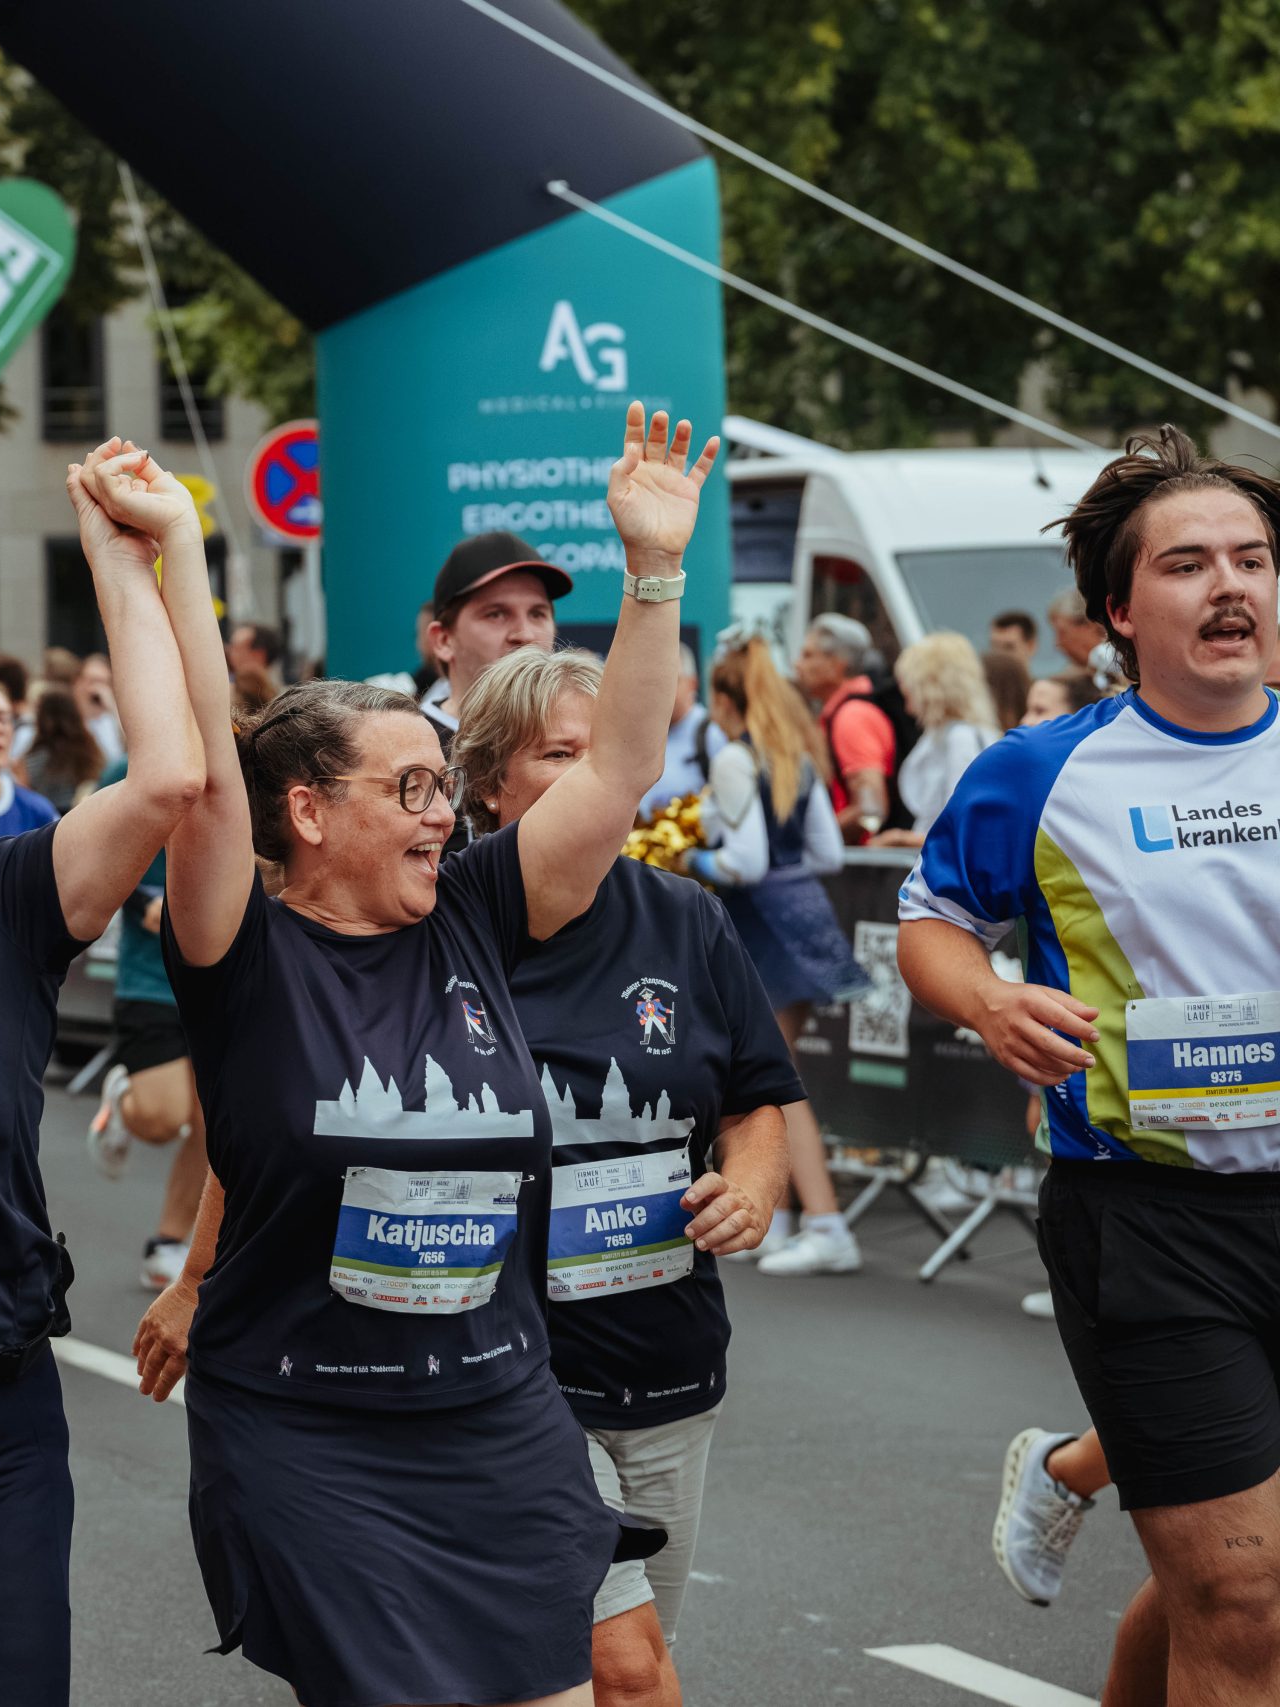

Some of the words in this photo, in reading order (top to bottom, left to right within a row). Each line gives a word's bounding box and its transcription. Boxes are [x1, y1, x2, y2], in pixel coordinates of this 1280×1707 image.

[538, 299, 628, 392] AG
[1172, 800, 1263, 821] Landes
[621, 981, 640, 999] Mainzer
[1187, 1012, 1210, 1021] LAUF
[1173, 1041, 1276, 1068] Hannes
[1210, 1070, 1242, 1084] 9375
[577, 1169, 599, 1178] FIRMEN
[578, 1178, 599, 1188] LAUF
[409, 1188, 429, 1198] LAUF
[585, 1204, 647, 1233] Anke
[367, 1214, 495, 1251] Katjuscha
[605, 1233, 633, 1248] 7659
[418, 1251, 446, 1264] 7656
[606, 1262, 633, 1272] Dexcom
[346, 1286, 368, 1298] BDO
[416, 1294, 427, 1302] dm
[551, 1284, 570, 1293] BDO
